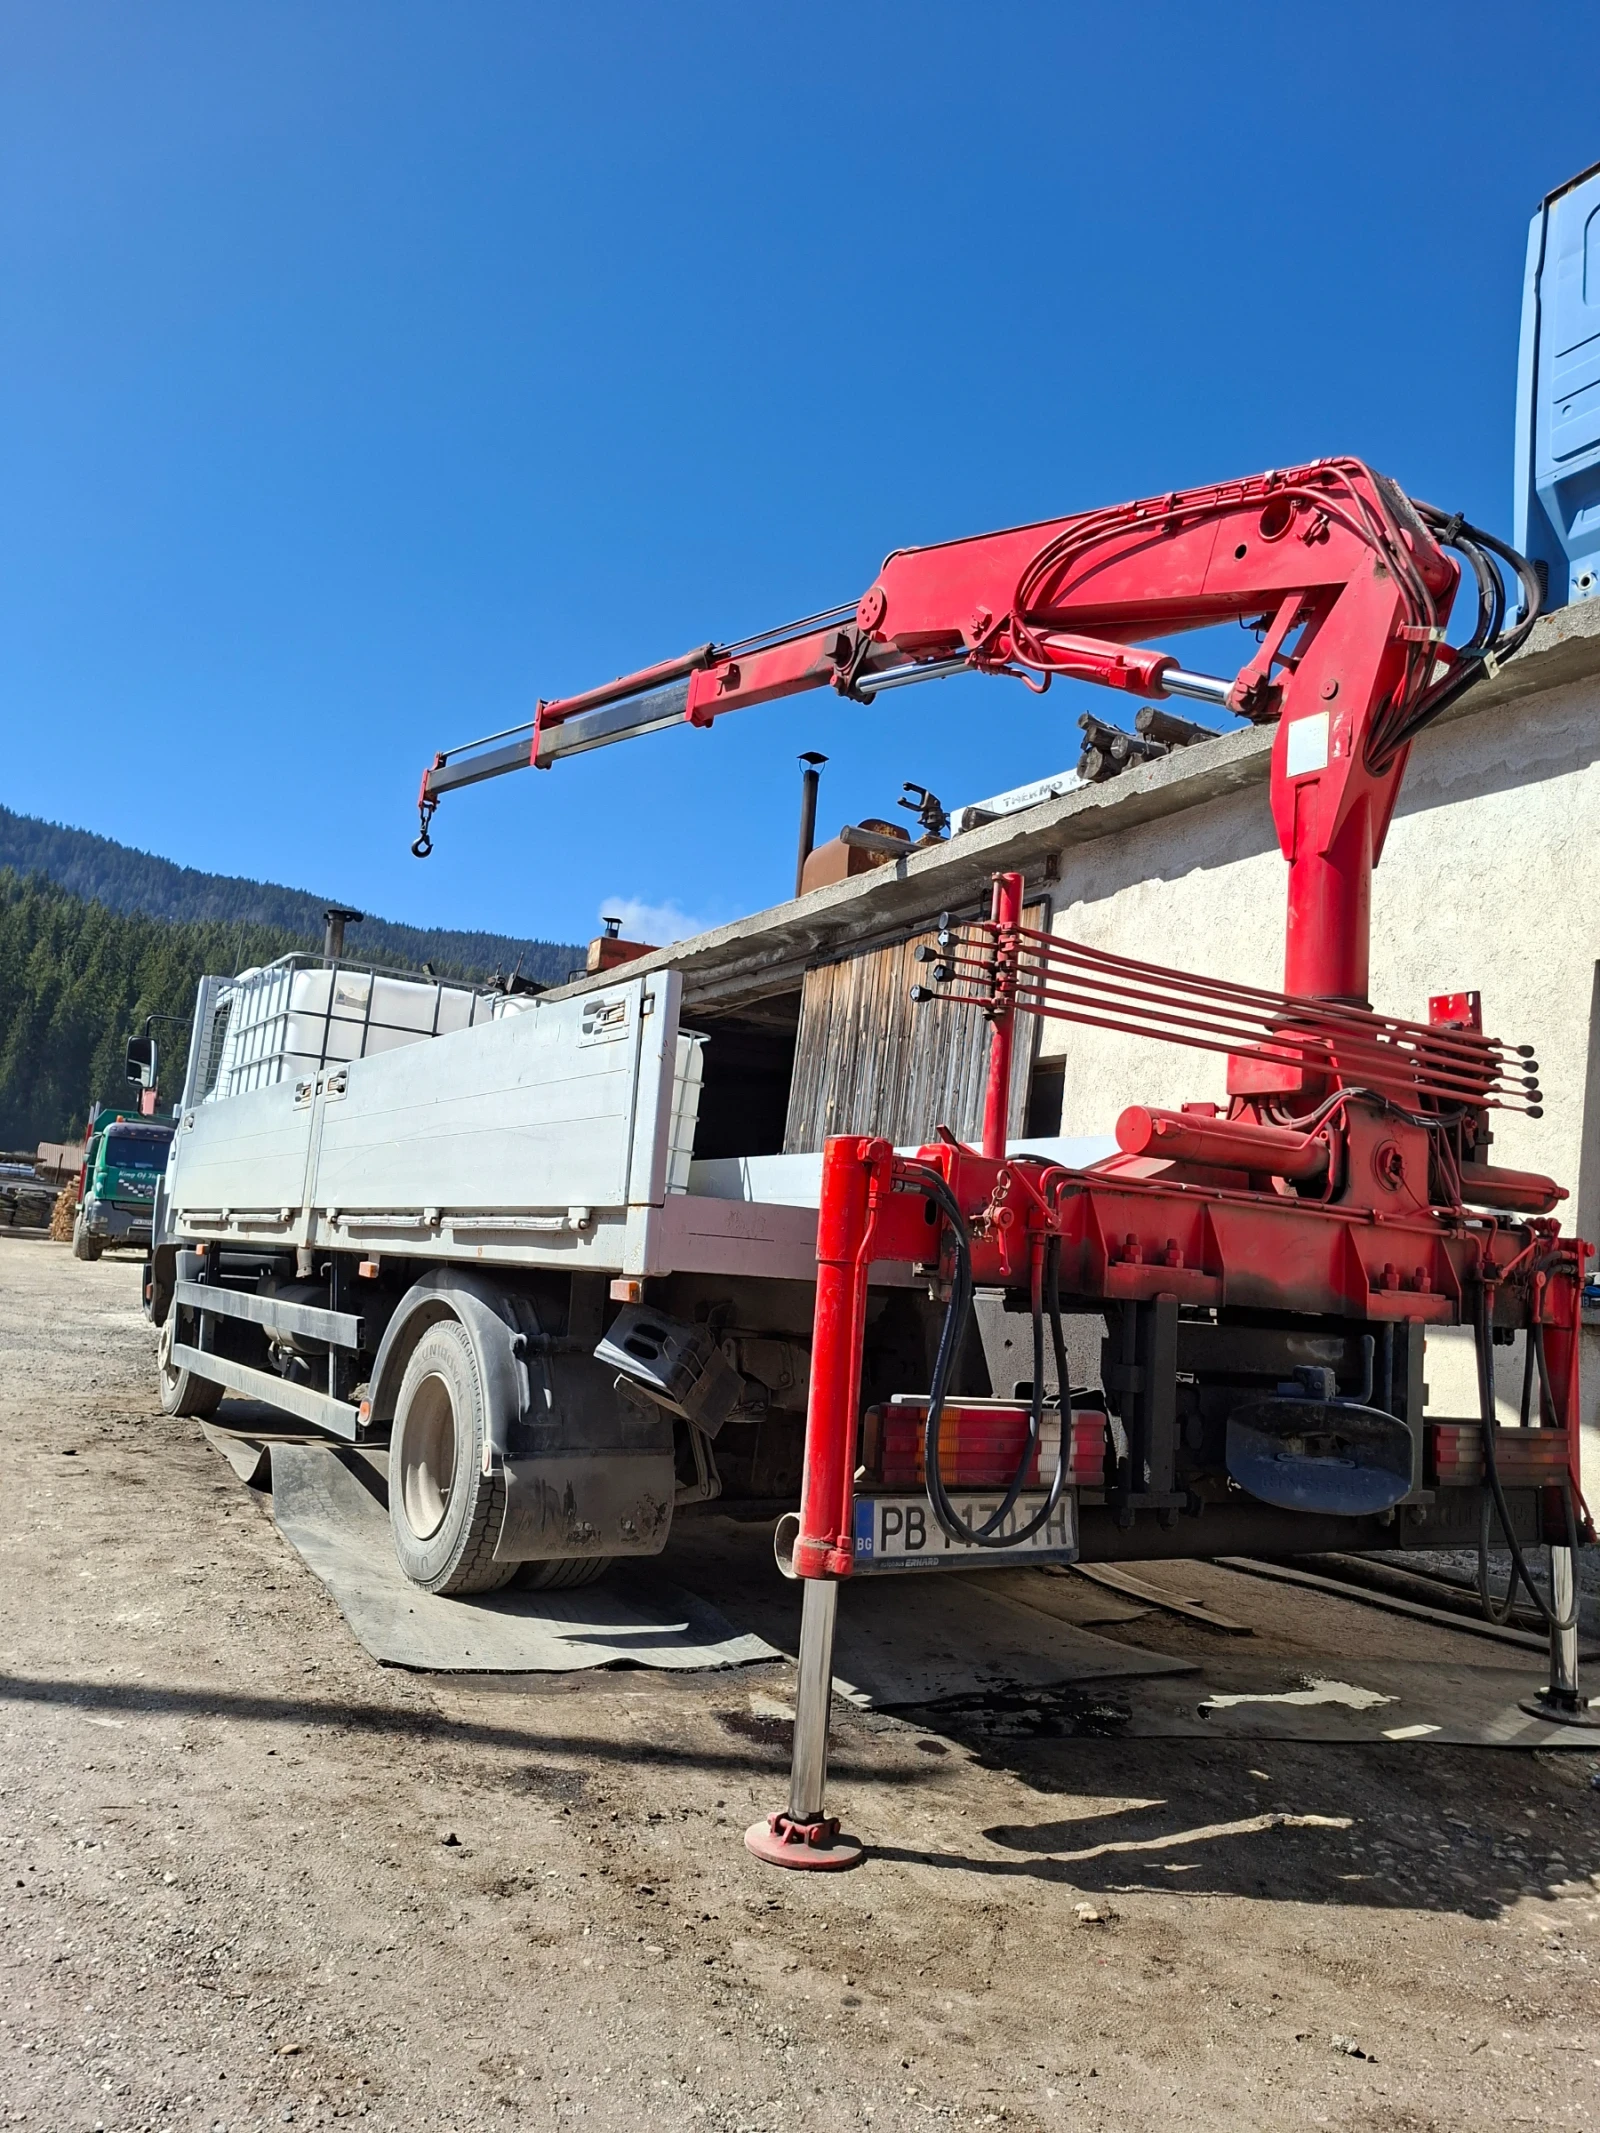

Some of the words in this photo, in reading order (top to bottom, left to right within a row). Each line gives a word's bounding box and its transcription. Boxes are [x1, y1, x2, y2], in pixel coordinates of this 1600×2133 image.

[880, 1507, 926, 1551] PB
[1025, 1502, 1067, 1546] TH
[857, 1537, 873, 1551] BG
